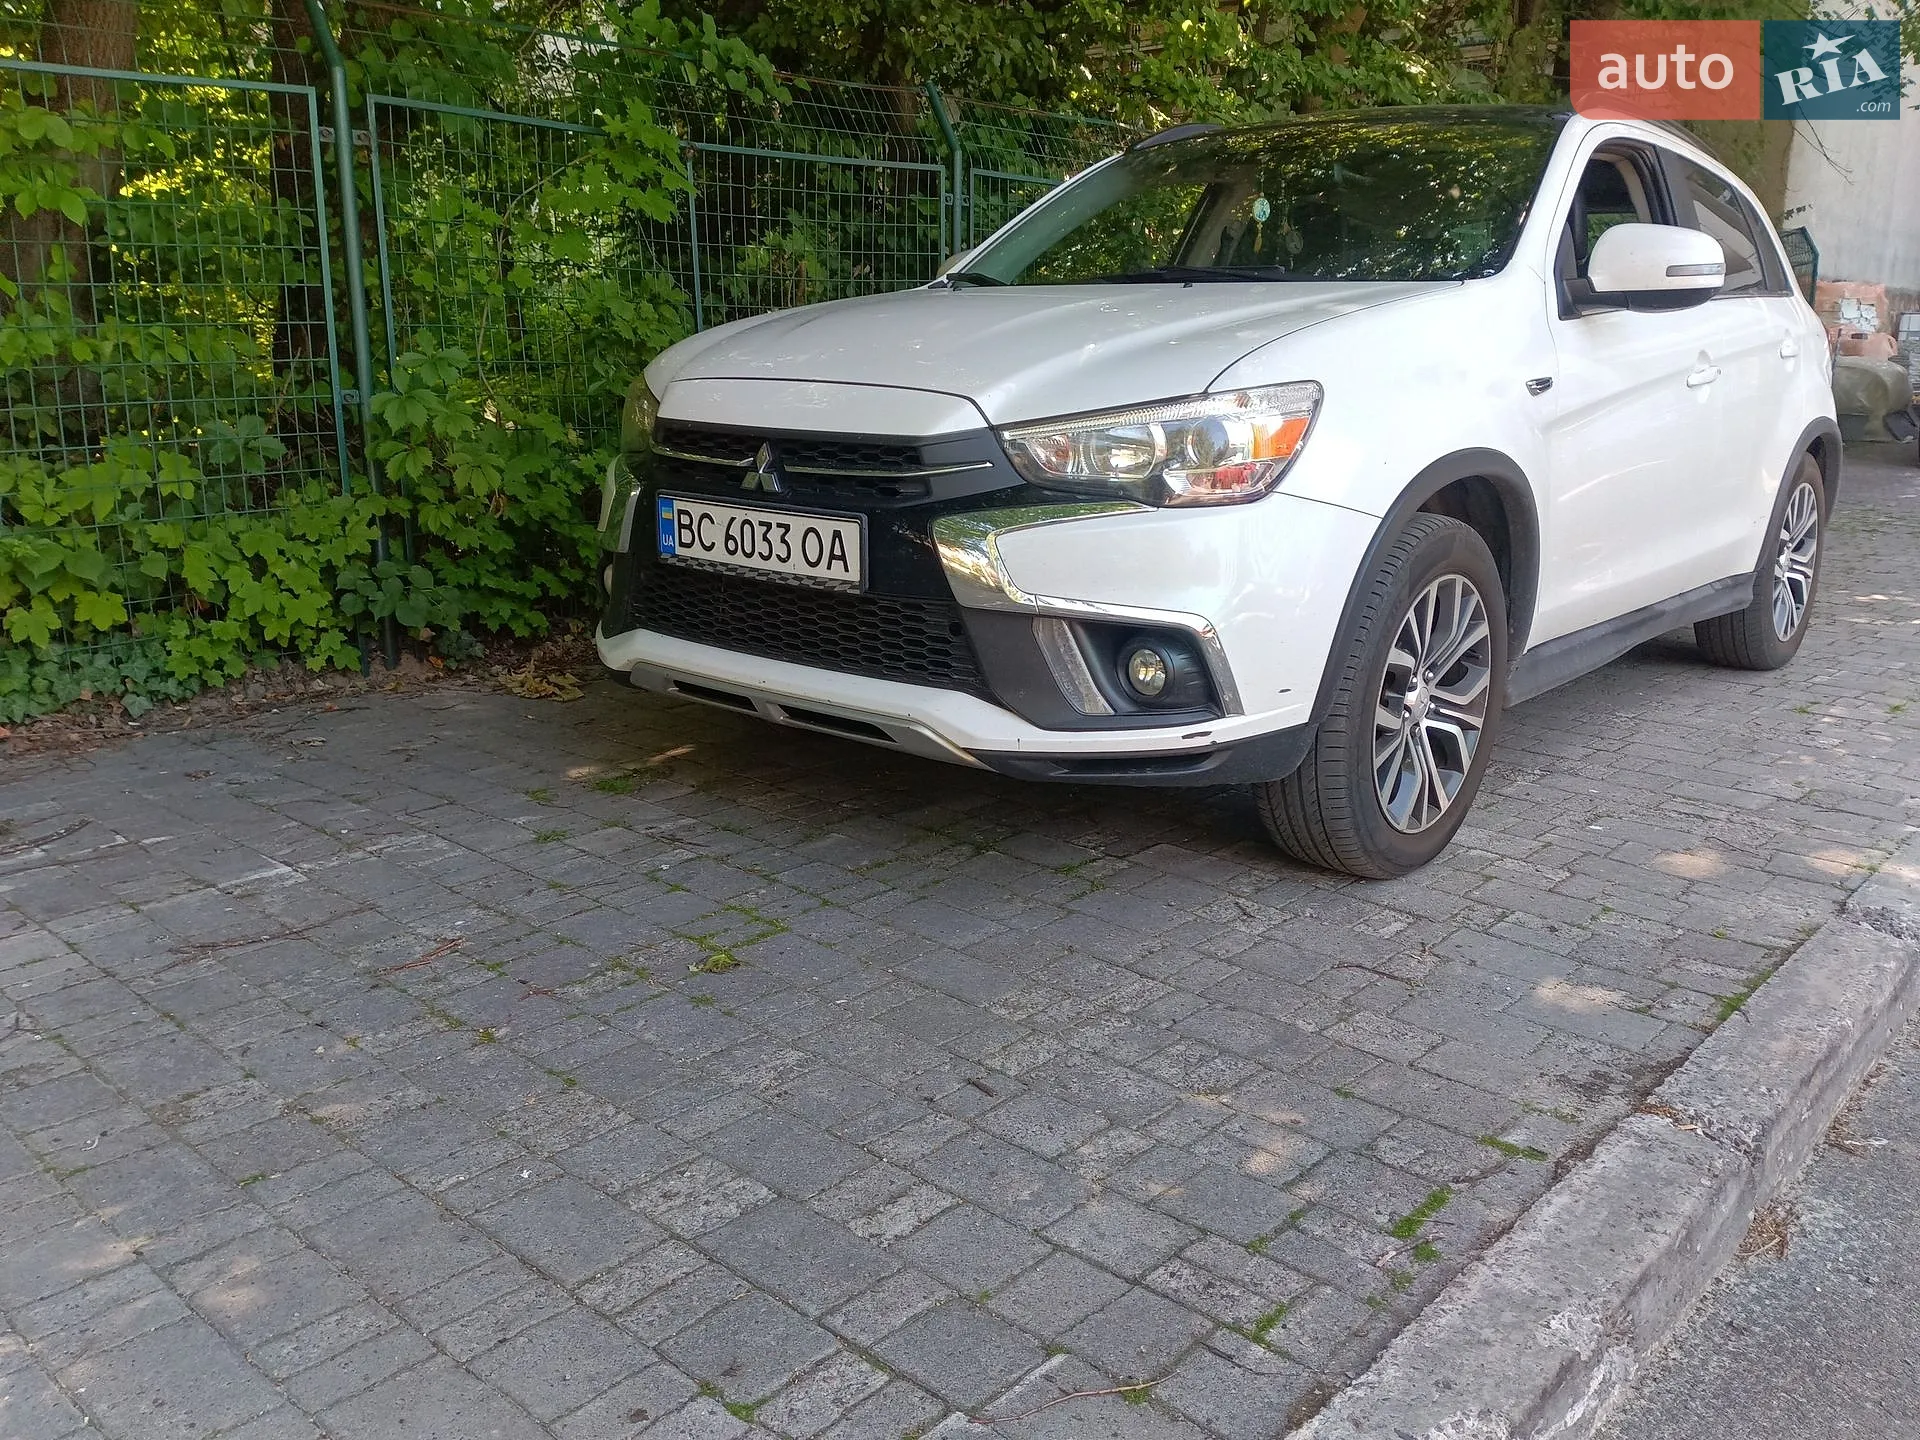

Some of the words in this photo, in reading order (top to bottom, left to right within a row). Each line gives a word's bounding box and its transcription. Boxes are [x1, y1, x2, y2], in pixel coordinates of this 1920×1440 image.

[662, 534, 675, 547] UA
[677, 508, 716, 552] BC
[724, 517, 791, 563] 6033
[801, 526, 850, 573] OA
